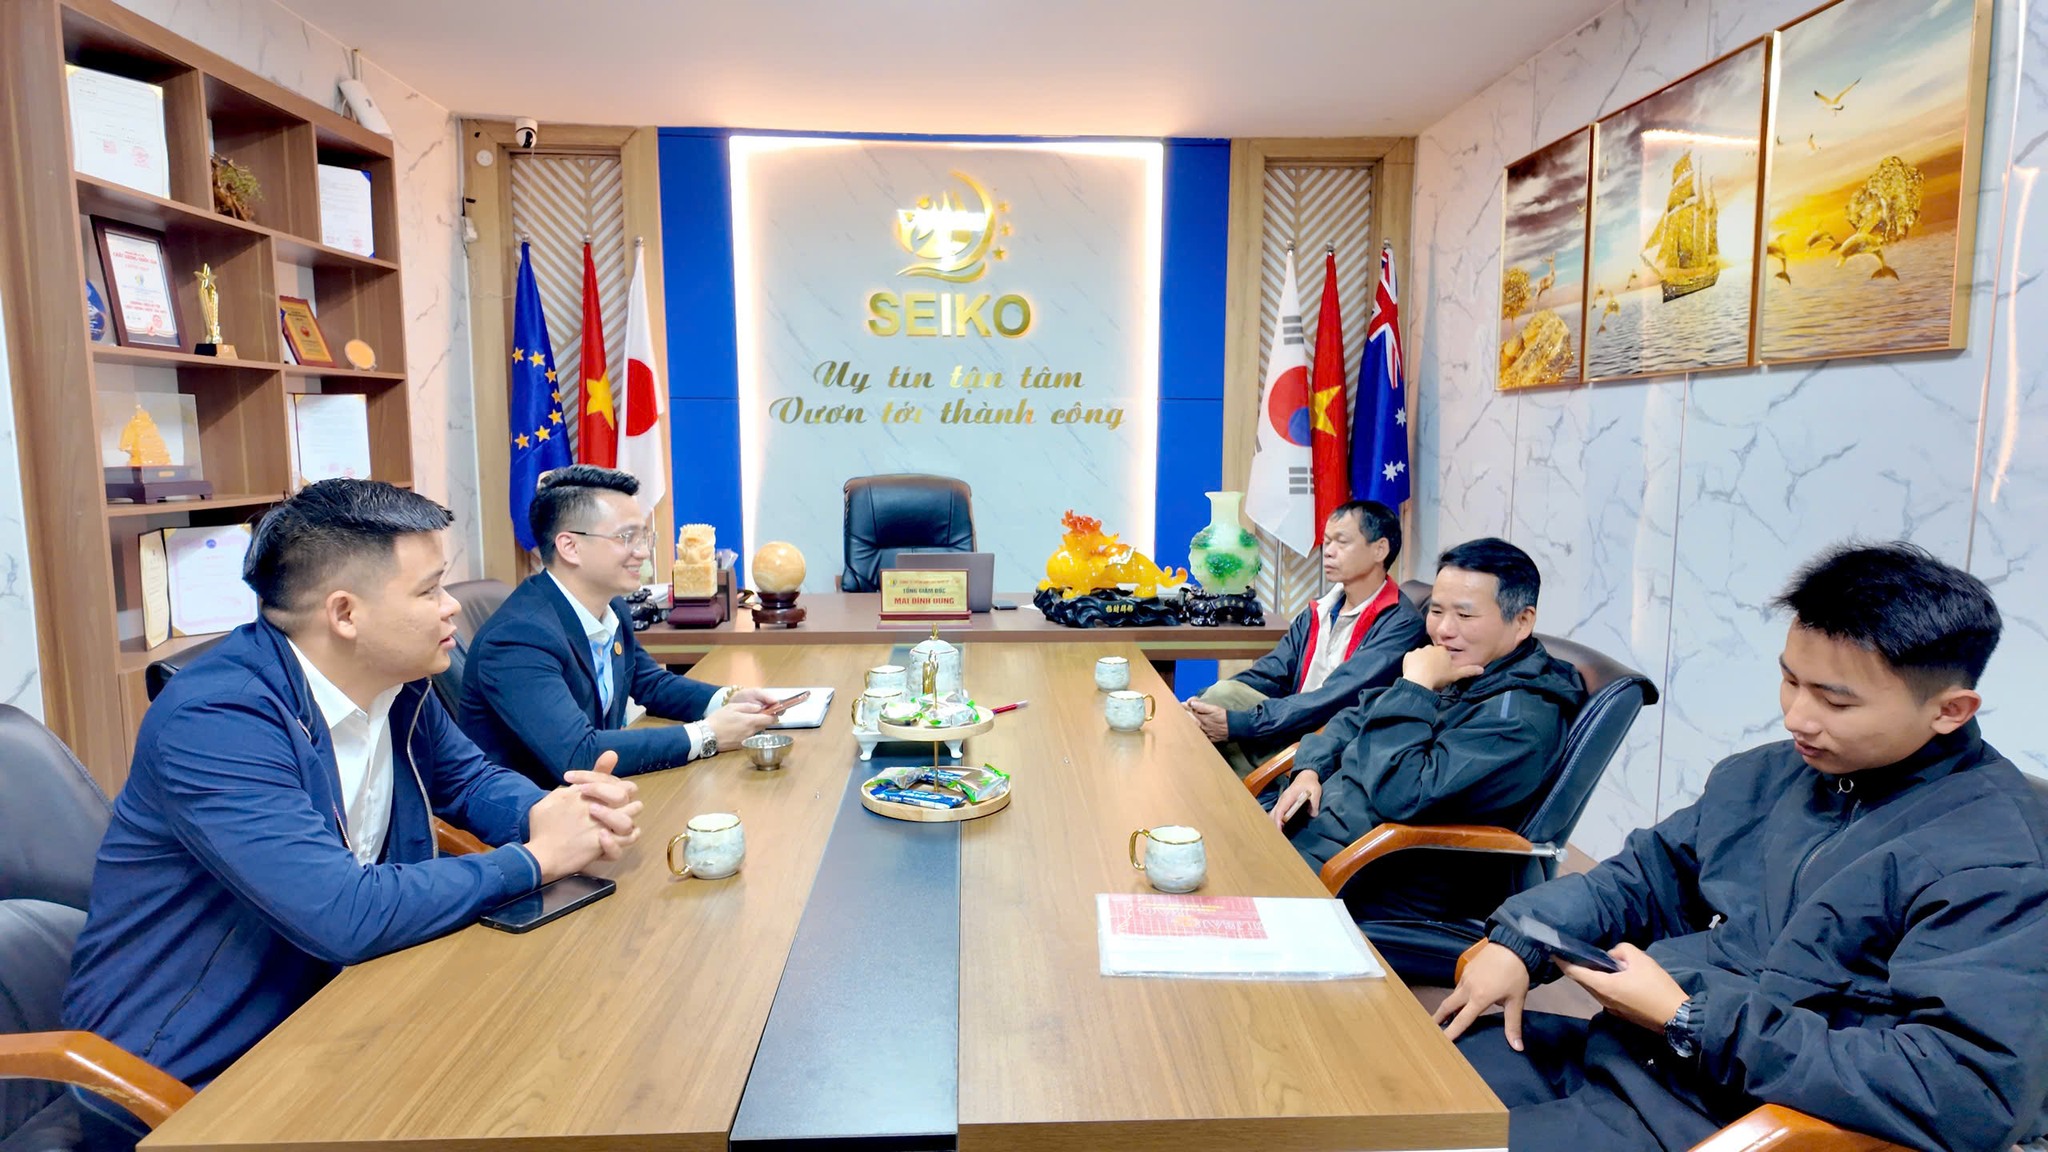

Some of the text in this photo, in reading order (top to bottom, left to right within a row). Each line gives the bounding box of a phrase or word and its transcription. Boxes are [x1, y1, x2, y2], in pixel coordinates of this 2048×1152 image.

[868, 292, 1032, 337] SEIKO
[813, 360, 872, 394] Uy
[1020, 365, 1085, 389] tâm
[940, 398, 1036, 426] thành
[1051, 402, 1126, 431] công
